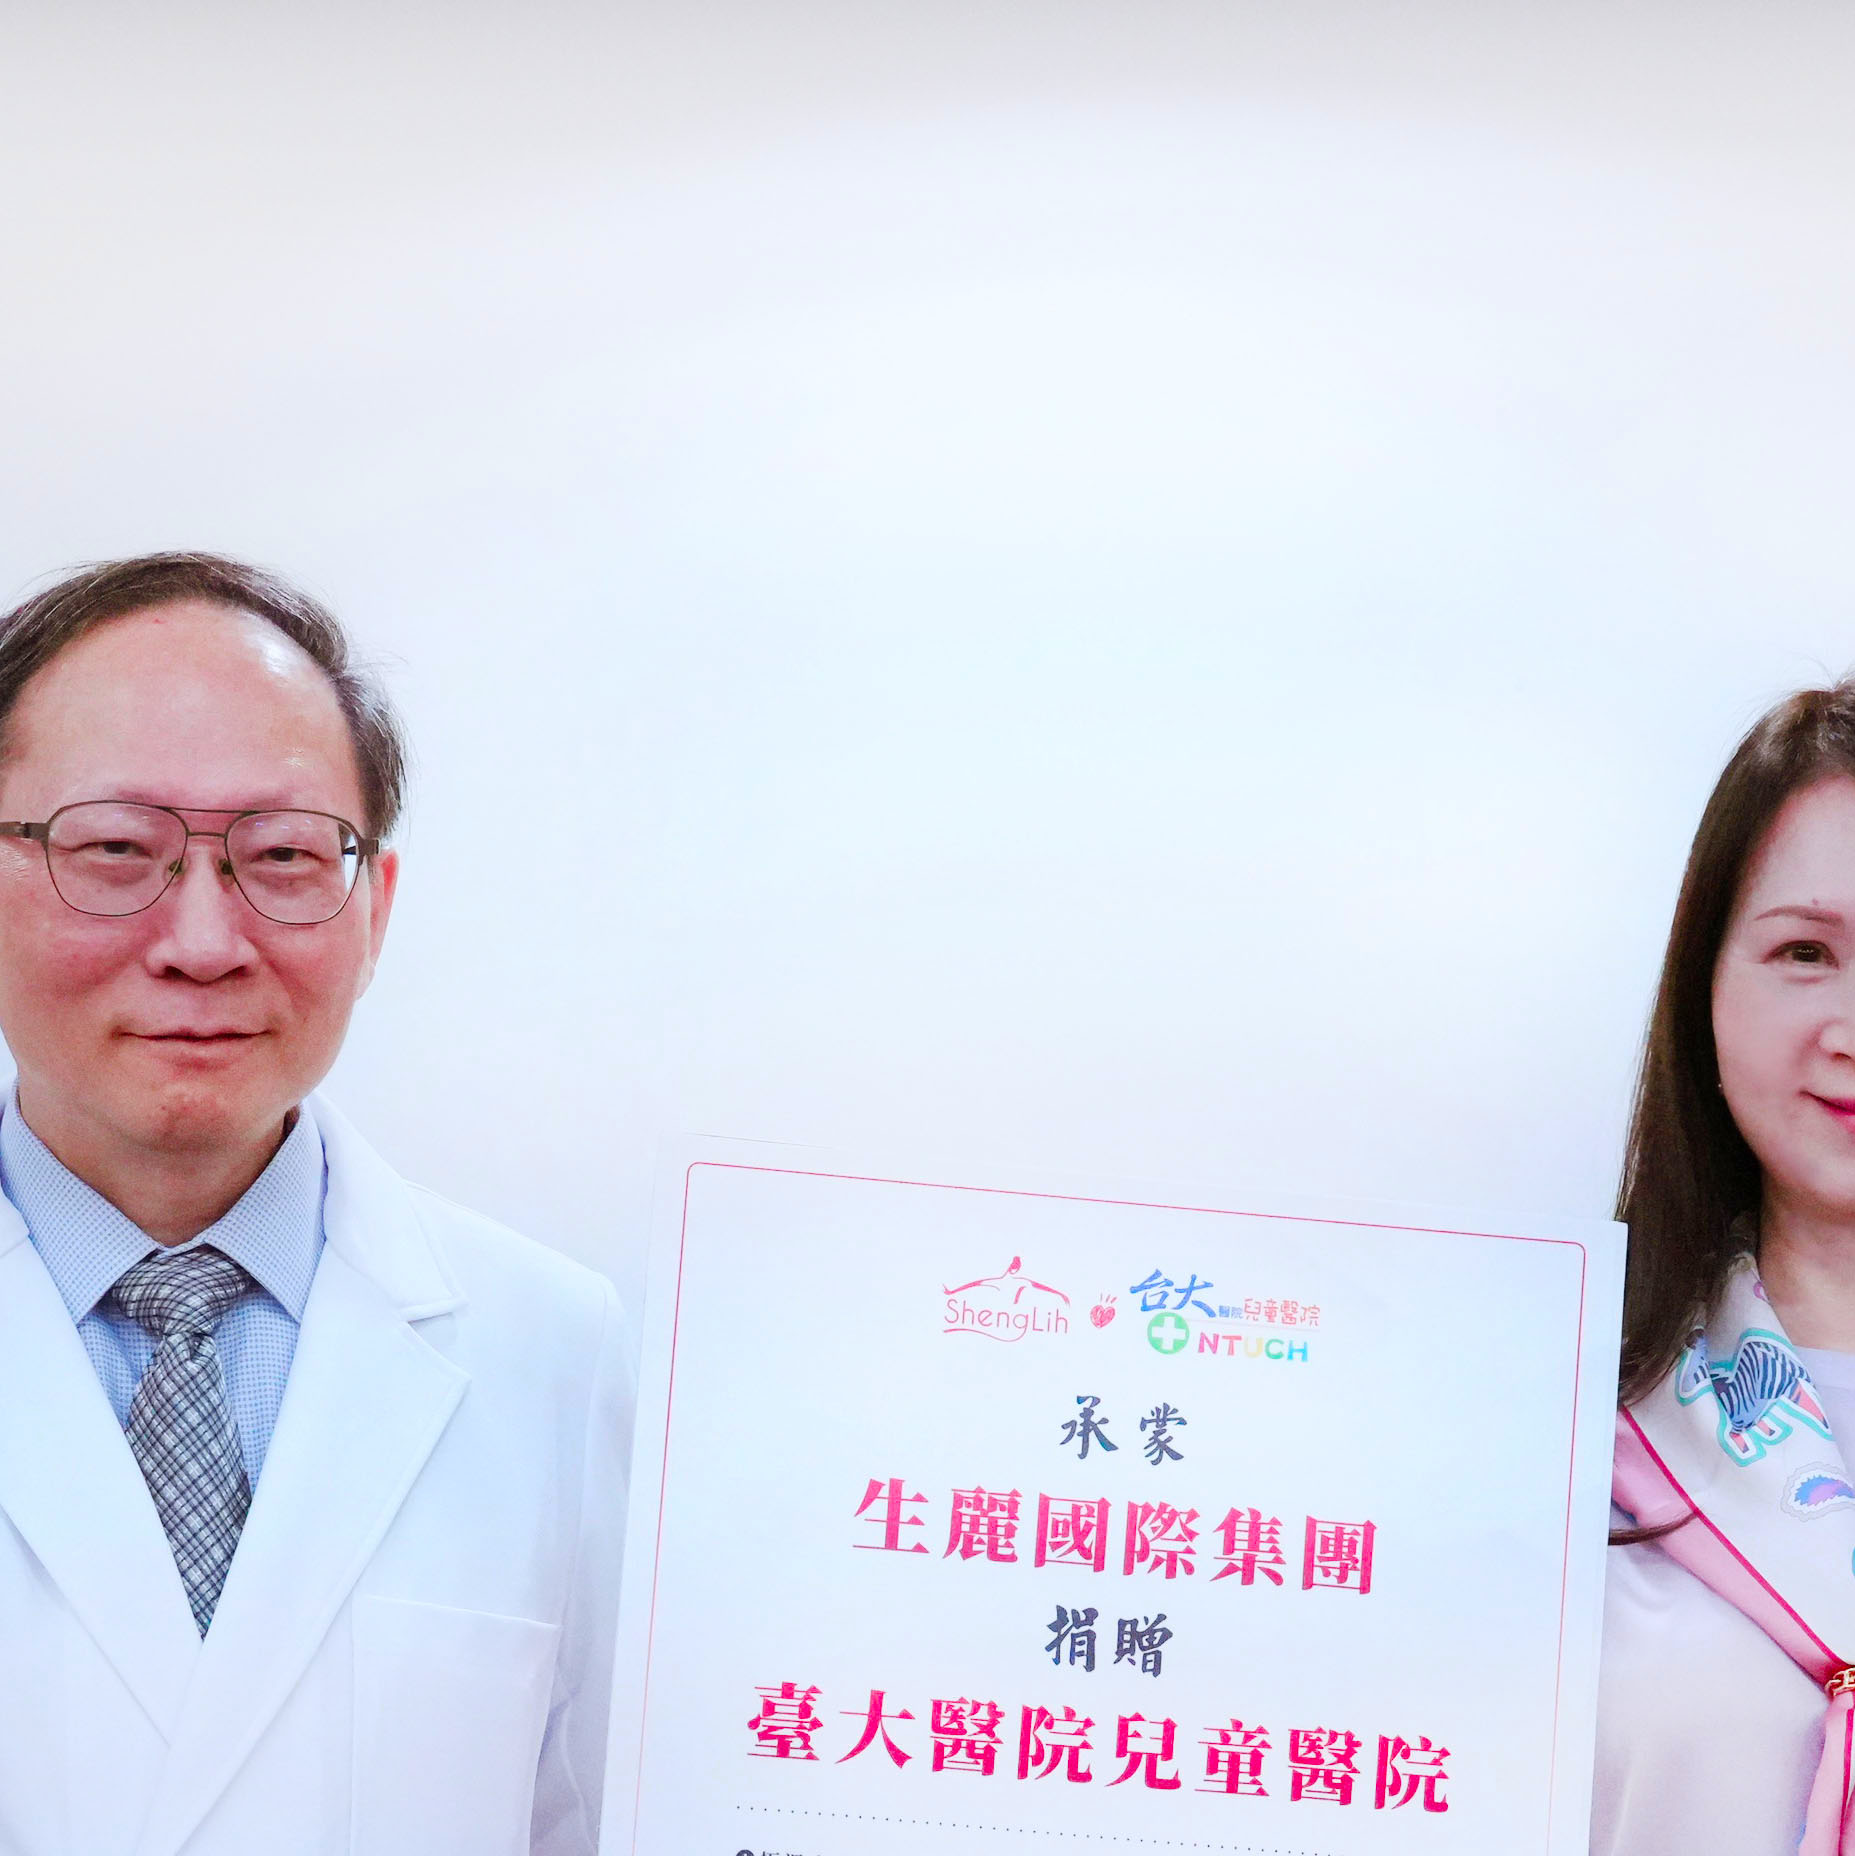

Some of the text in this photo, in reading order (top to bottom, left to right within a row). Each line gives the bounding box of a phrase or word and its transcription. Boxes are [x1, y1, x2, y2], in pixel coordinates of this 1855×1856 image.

[944, 1298, 1069, 1338] ShengLih
[1197, 1331, 1309, 1363] NTUCH
[1059, 1395, 1188, 1466] 承蒙
[852, 1477, 1378, 1595] 生麗國際集團
[1045, 1604, 1174, 1678] 捐贈
[746, 1680, 1452, 1814] 臺大醫院兒童醫院
